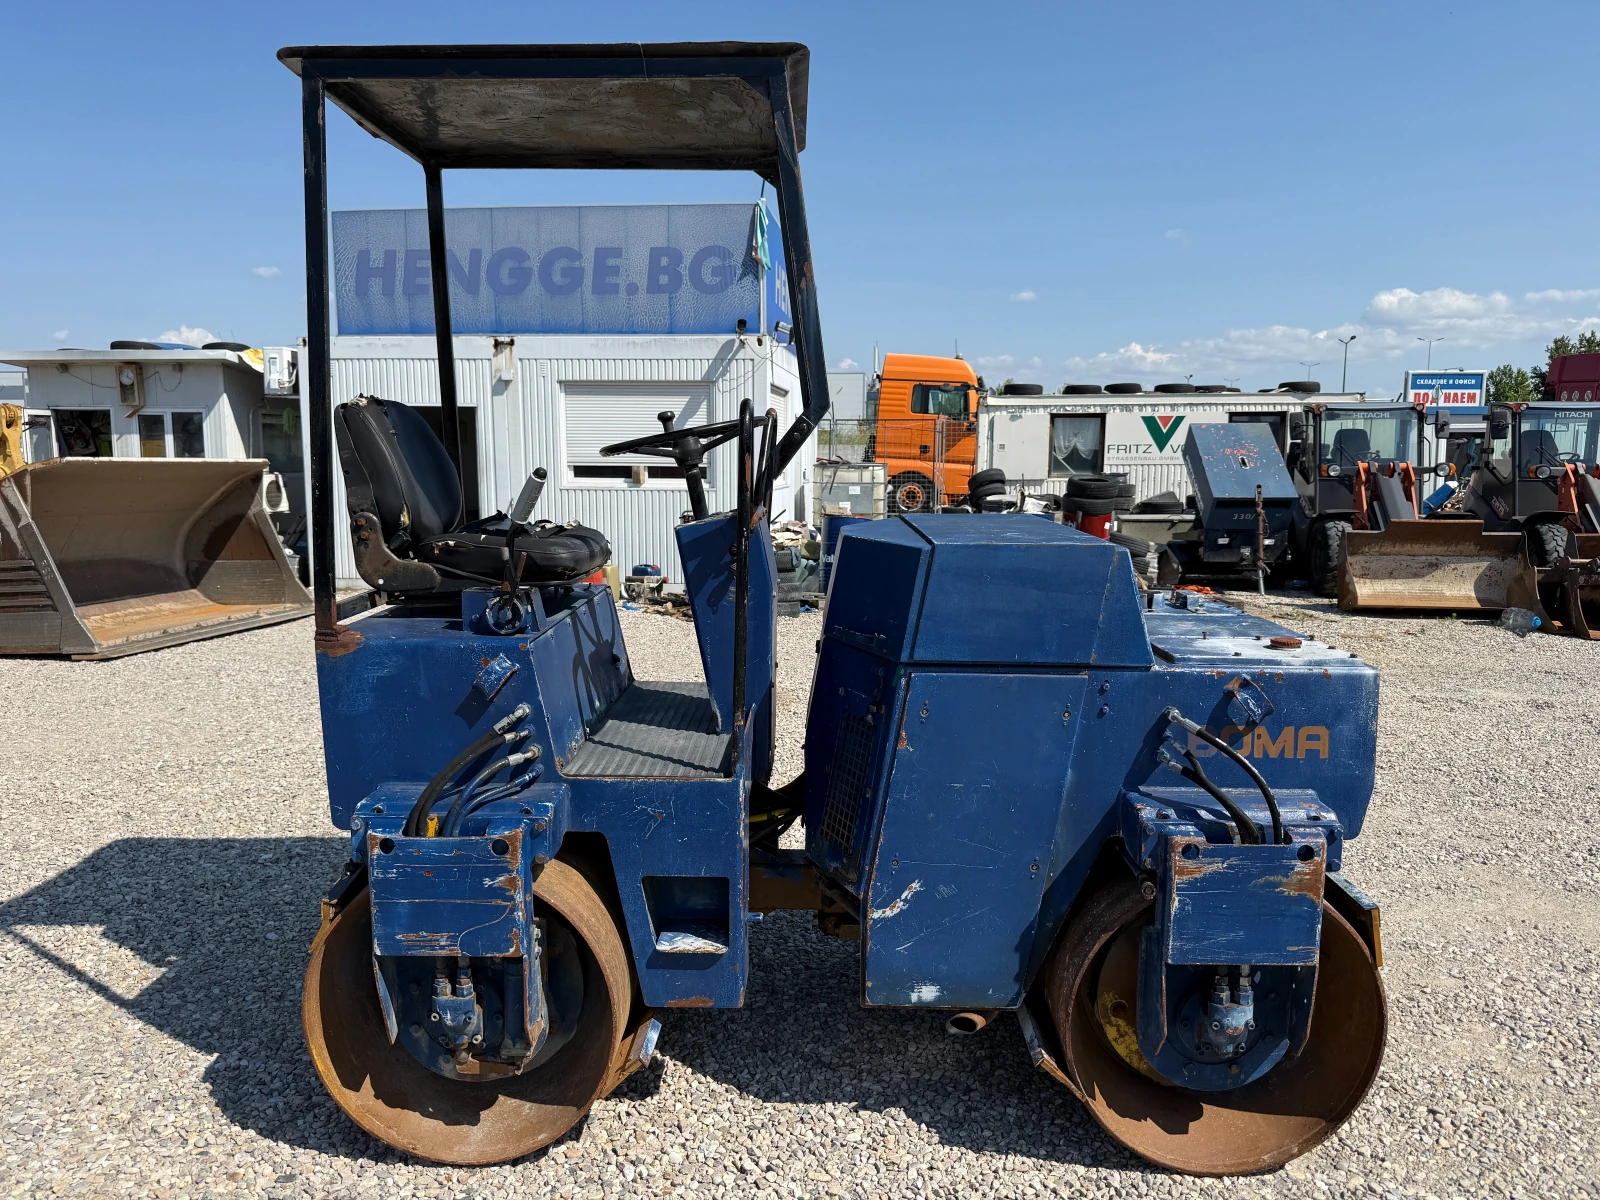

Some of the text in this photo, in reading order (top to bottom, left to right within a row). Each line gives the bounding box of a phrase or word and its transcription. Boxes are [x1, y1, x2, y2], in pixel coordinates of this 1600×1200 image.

[354, 244, 737, 297] HENGGE.BG
[775, 260, 792, 319] HE
[1443, 392, 1477, 404] НАЕМ
[1353, 411, 1390, 419] HITACHI
[1107, 444, 1153, 454] FRITZ
